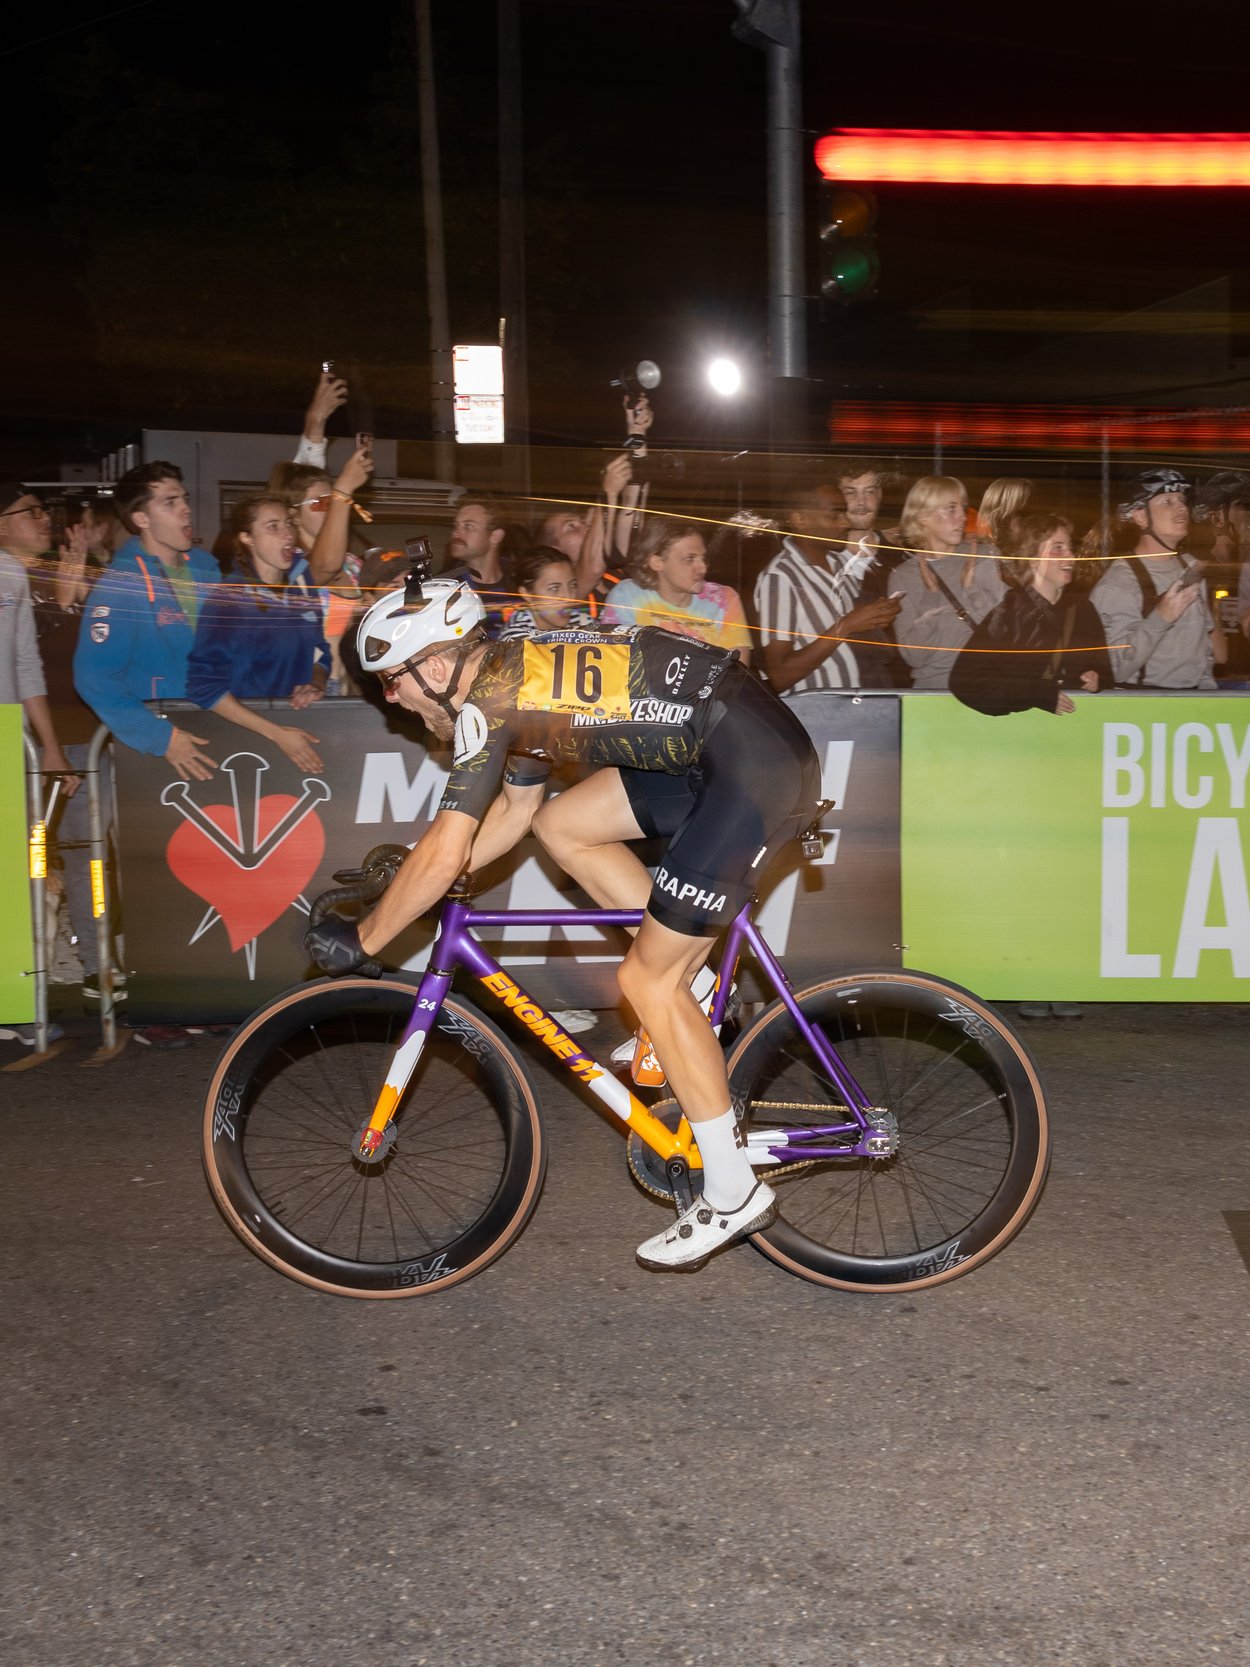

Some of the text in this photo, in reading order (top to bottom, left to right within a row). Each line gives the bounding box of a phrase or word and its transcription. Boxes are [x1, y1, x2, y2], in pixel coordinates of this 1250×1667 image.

[552, 631, 600, 640] FIXED GEAR
[550, 645, 602, 704] 16
[671, 654, 691, 695] OAKLEY
[656, 867, 727, 912] RAPHA
[418, 998, 436, 1011] 24
[480, 971, 582, 1060] ENGINE
[570, 1058, 605, 1082] 11
